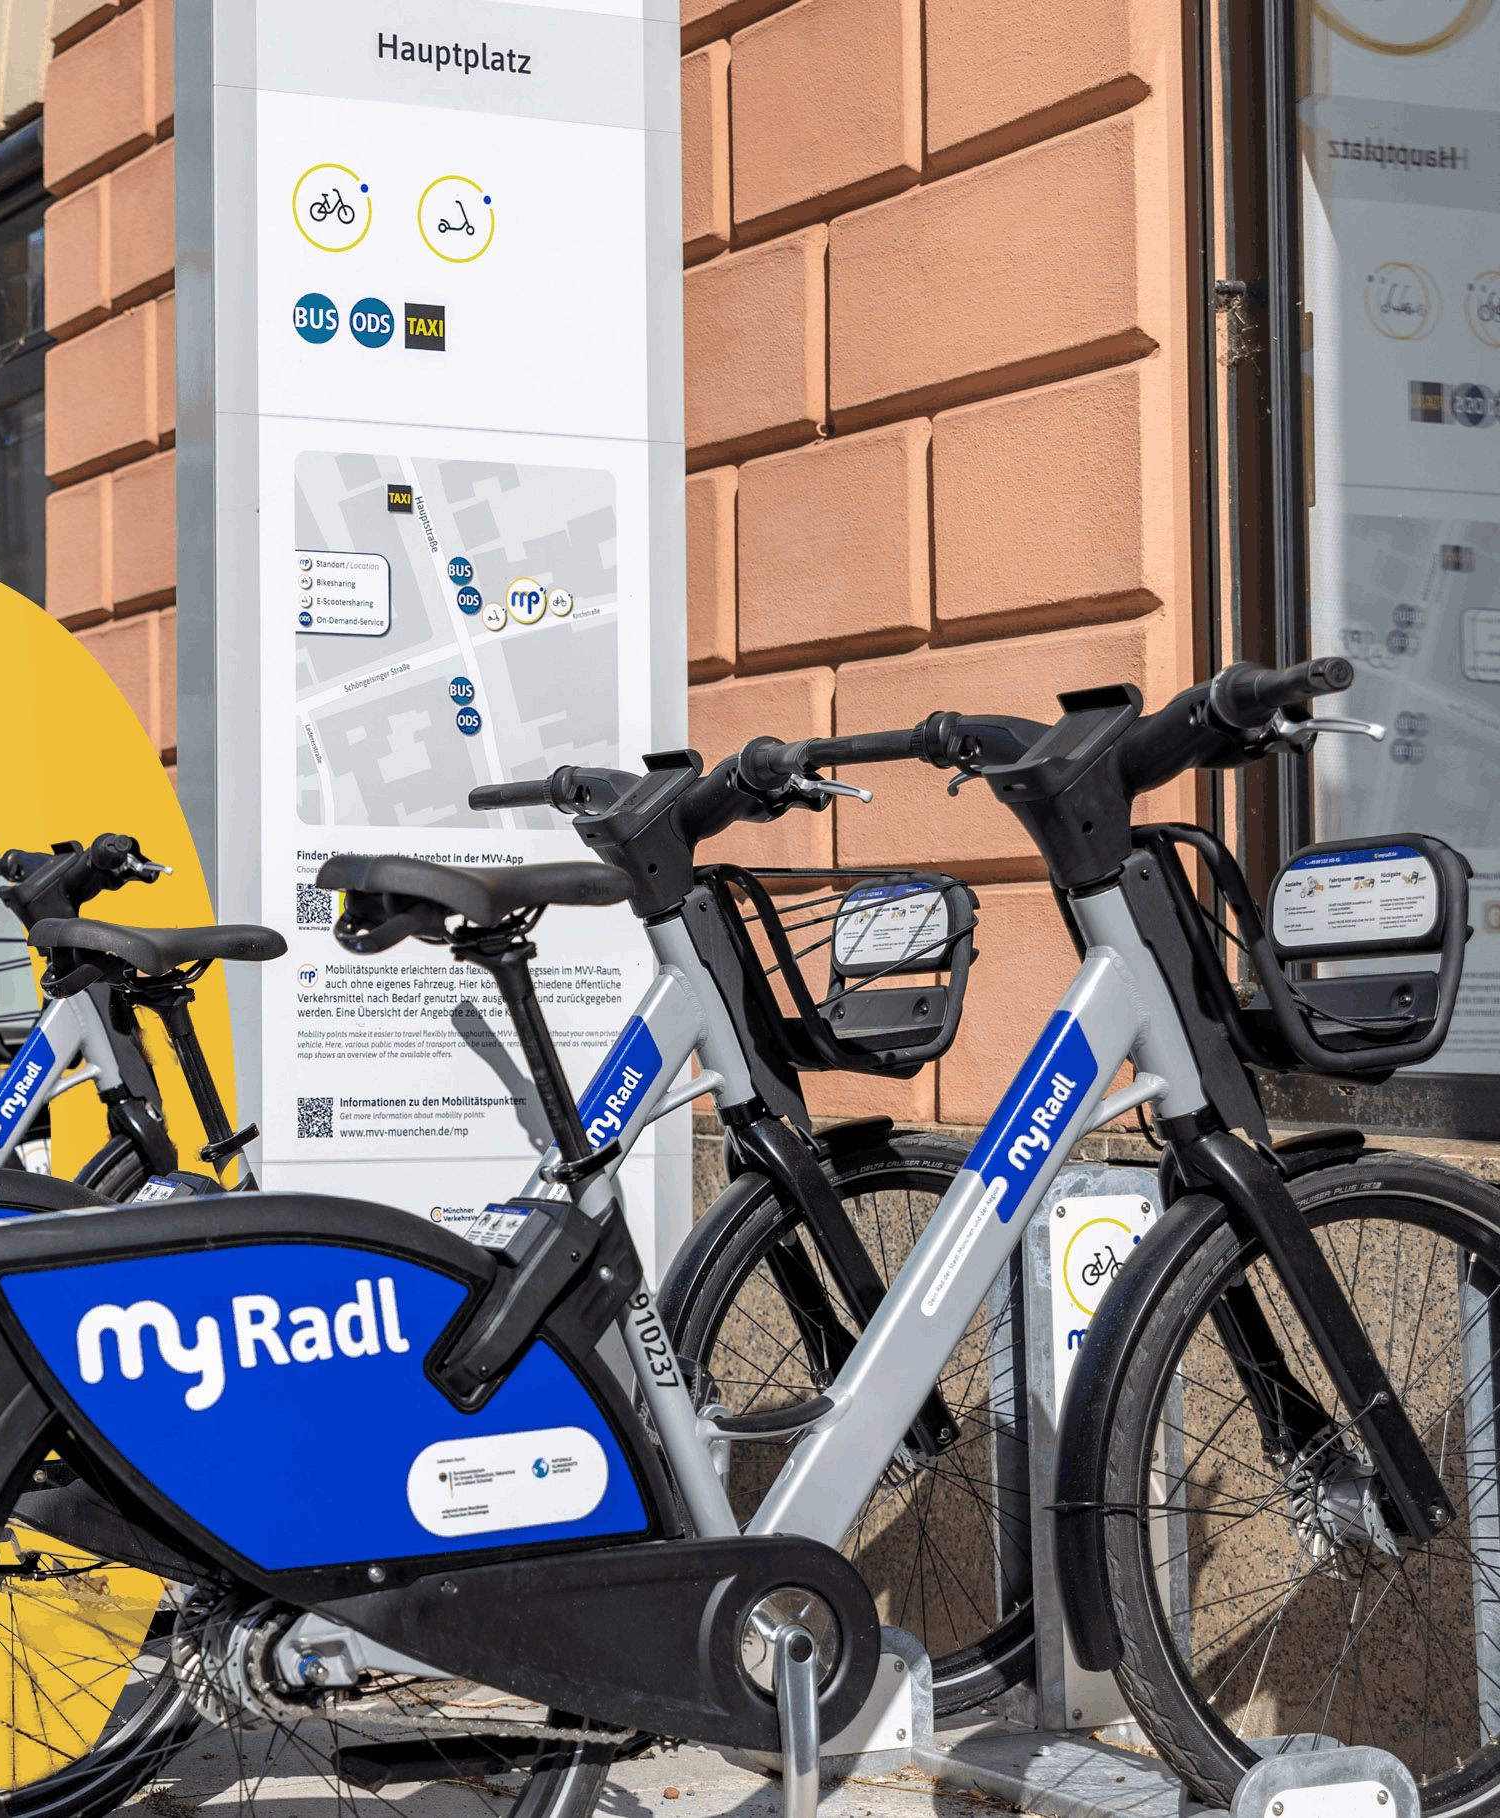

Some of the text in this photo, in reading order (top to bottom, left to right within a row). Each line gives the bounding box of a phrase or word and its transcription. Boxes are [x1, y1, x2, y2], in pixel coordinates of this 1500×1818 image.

[378, 32, 531, 75] Hauptplatz
[294, 306, 444, 338] BUS ODS TAXI
[388, 492, 411, 505] TAXI
[414, 495, 439, 553] Hauptstraße
[448, 564, 472, 578] BUS
[316, 578, 356, 590] Bikesharing
[316, 597, 374, 609] E-Scootersharing
[458, 594, 480, 606] ODS
[572, 608, 601, 620] Kirchstraße
[316, 615, 385, 627] On-Demand-Service
[343, 662, 411, 694] Schöngeisinger Straße
[449, 684, 473, 698] BUS
[457, 715, 479, 727] ODS
[296, 850, 329, 861] Finden
[453, 852, 462, 863] in
[464, 853, 479, 863] der
[481, 853, 524, 866] MVV-App
[296, 865, 320, 874] Choos
[325, 964, 399, 977] Mobilitätspunkte
[400, 964, 447, 975] erleichtern
[449, 965, 464, 975] das
[466, 965, 492, 975] flexib
[561, 966, 572, 976] im
[574, 966, 622, 977] MVV-Raum,
[325, 979, 347, 989] auch
[350, 979, 373, 989] ohne
[376, 979, 411, 991] eigenes
[413, 979, 457, 991] Fahrzeug.
[459, 979, 477, 989] Hier
[575, 979, 622, 990] öffentliche
[297, 993, 622, 1006] Verkehrsmittel nach Bedarf genutzt bzw. und zurückgegeben
[297, 1007, 334, 1017] werden.
[336, 1007, 356, 1017] Eine
[357, 1005, 401, 1017] Übersicht
[403, 1007, 418, 1017] der
[420, 1007, 463, 1019] Angebote
[465, 1008, 487, 1019] zeigt
[489, 1007, 503, 1017] die
[297, 1030, 326, 1040] Mobility
[326, 1030, 347, 1039] points
[349, 1030, 367, 1038] make
[373, 1030, 393, 1038] easier
[394, 1030, 402, 1038] to
[402, 1030, 422, 1038] travel
[423, 1029, 447, 1039] flexibly
[497, 1030, 513, 1038] MVV
[569, 1031, 584, 1039] your
[297, 1040, 324, 1048] vehicle.
[324, 1040, 343, 1049] Here,
[370, 1040, 392, 1049] public
[393, 1040, 416, 1048] modes
[417, 1040, 425, 1048] of
[425, 1041, 457, 1049] transport
[481, 1040, 497, 1048] used
[580, 1040, 608, 1048] required.
[297, 1052, 313, 1060] map
[314, 1051, 336, 1059] shows
[346, 1051, 378, 1059] overview
[378, 1050, 387, 1058] of
[387, 1050, 399, 1058] the
[399, 1050, 431, 1058] available
[431, 1050, 453, 1058] offers.
[339, 1096, 527, 1108] Informationen zu den Mobilitätspunkten:
[339, 1112, 352, 1120] Get
[372, 1112, 413, 1120] information
[413, 1111, 434, 1119] about
[434, 1111, 462, 1120] mobility
[463, 1111, 486, 1120] points:
[339, 1126, 469, 1138] www.mvv-muenchen.de/mp
[886, 1159, 920, 1169] CRUISER
[921, 1160, 944, 1169] PLUS
[1333, 1184, 1357, 1196] PLUS
[442, 1206, 475, 1215] Münchner
[1182, 1255, 1225, 1318] SCHWALBE
[631, 1292, 680, 1389] 910237
